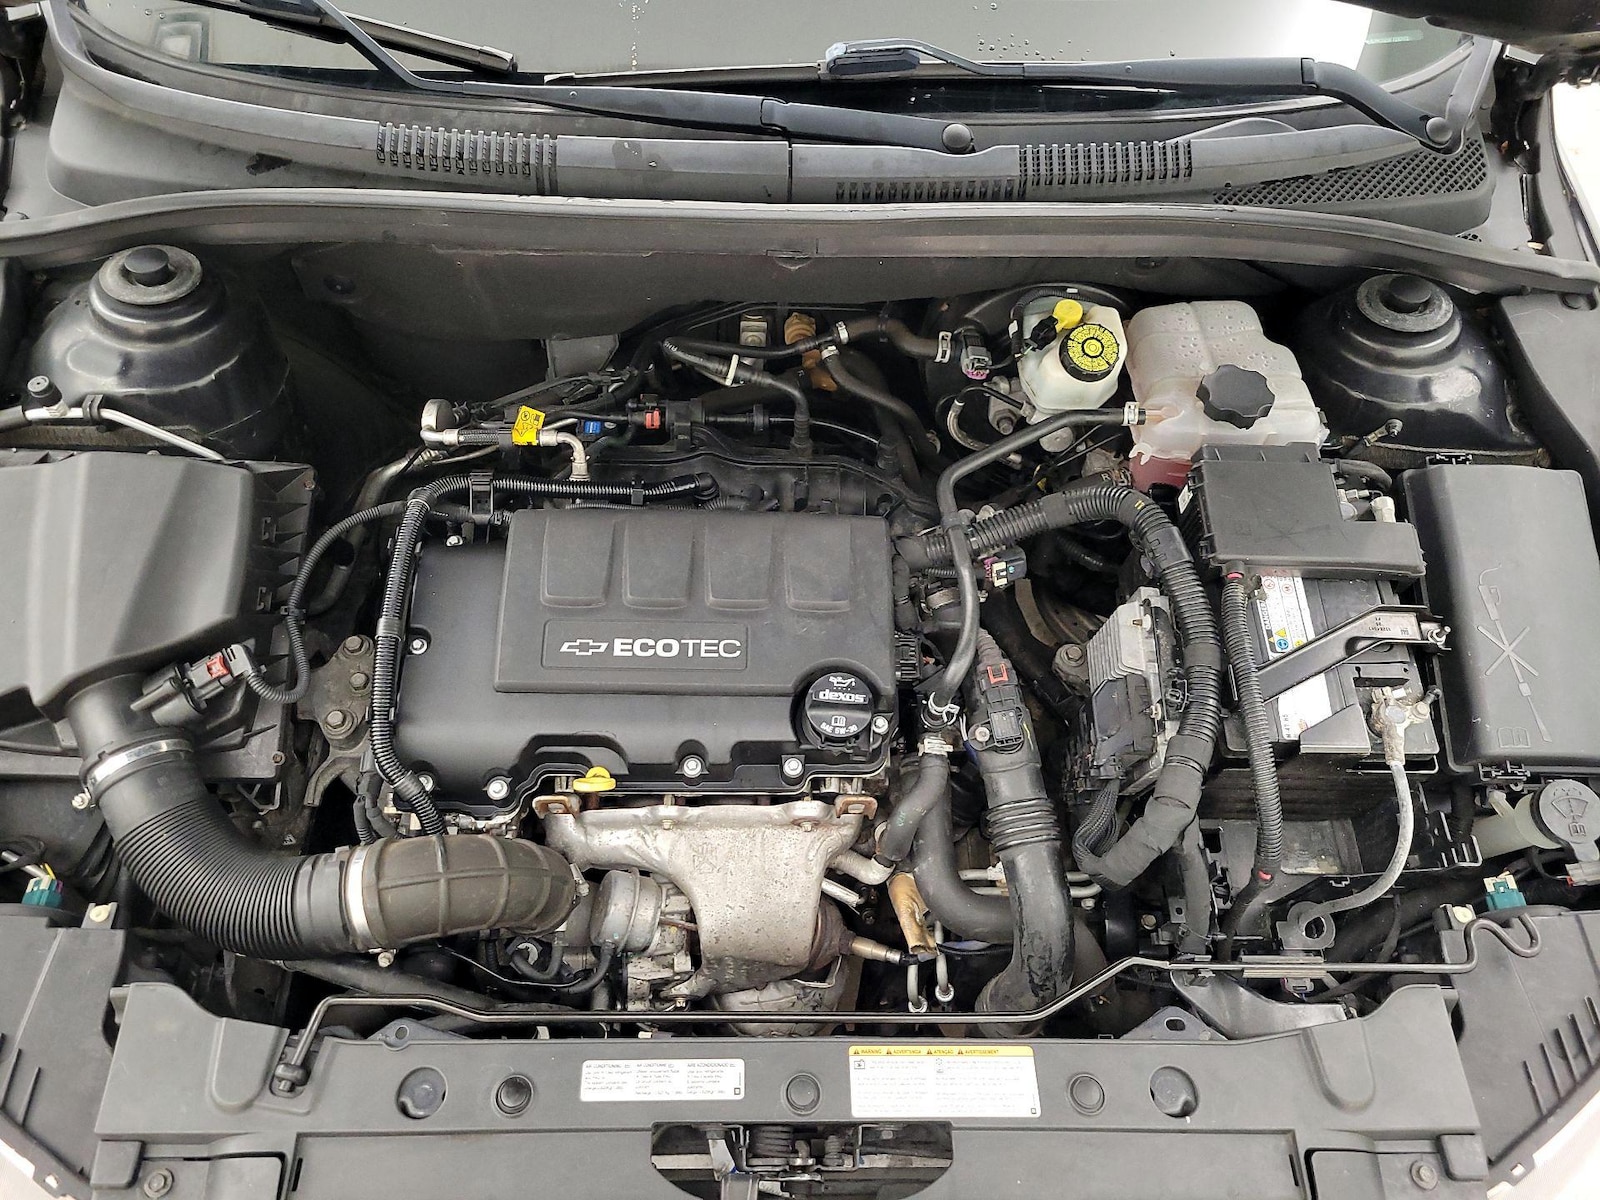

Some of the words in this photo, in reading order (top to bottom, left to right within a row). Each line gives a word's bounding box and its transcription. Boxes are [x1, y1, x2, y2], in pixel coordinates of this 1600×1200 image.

[1260, 600, 1271, 630] DANGER
[613, 638, 741, 658] ECOTEC
[819, 689, 866, 702] dexos
